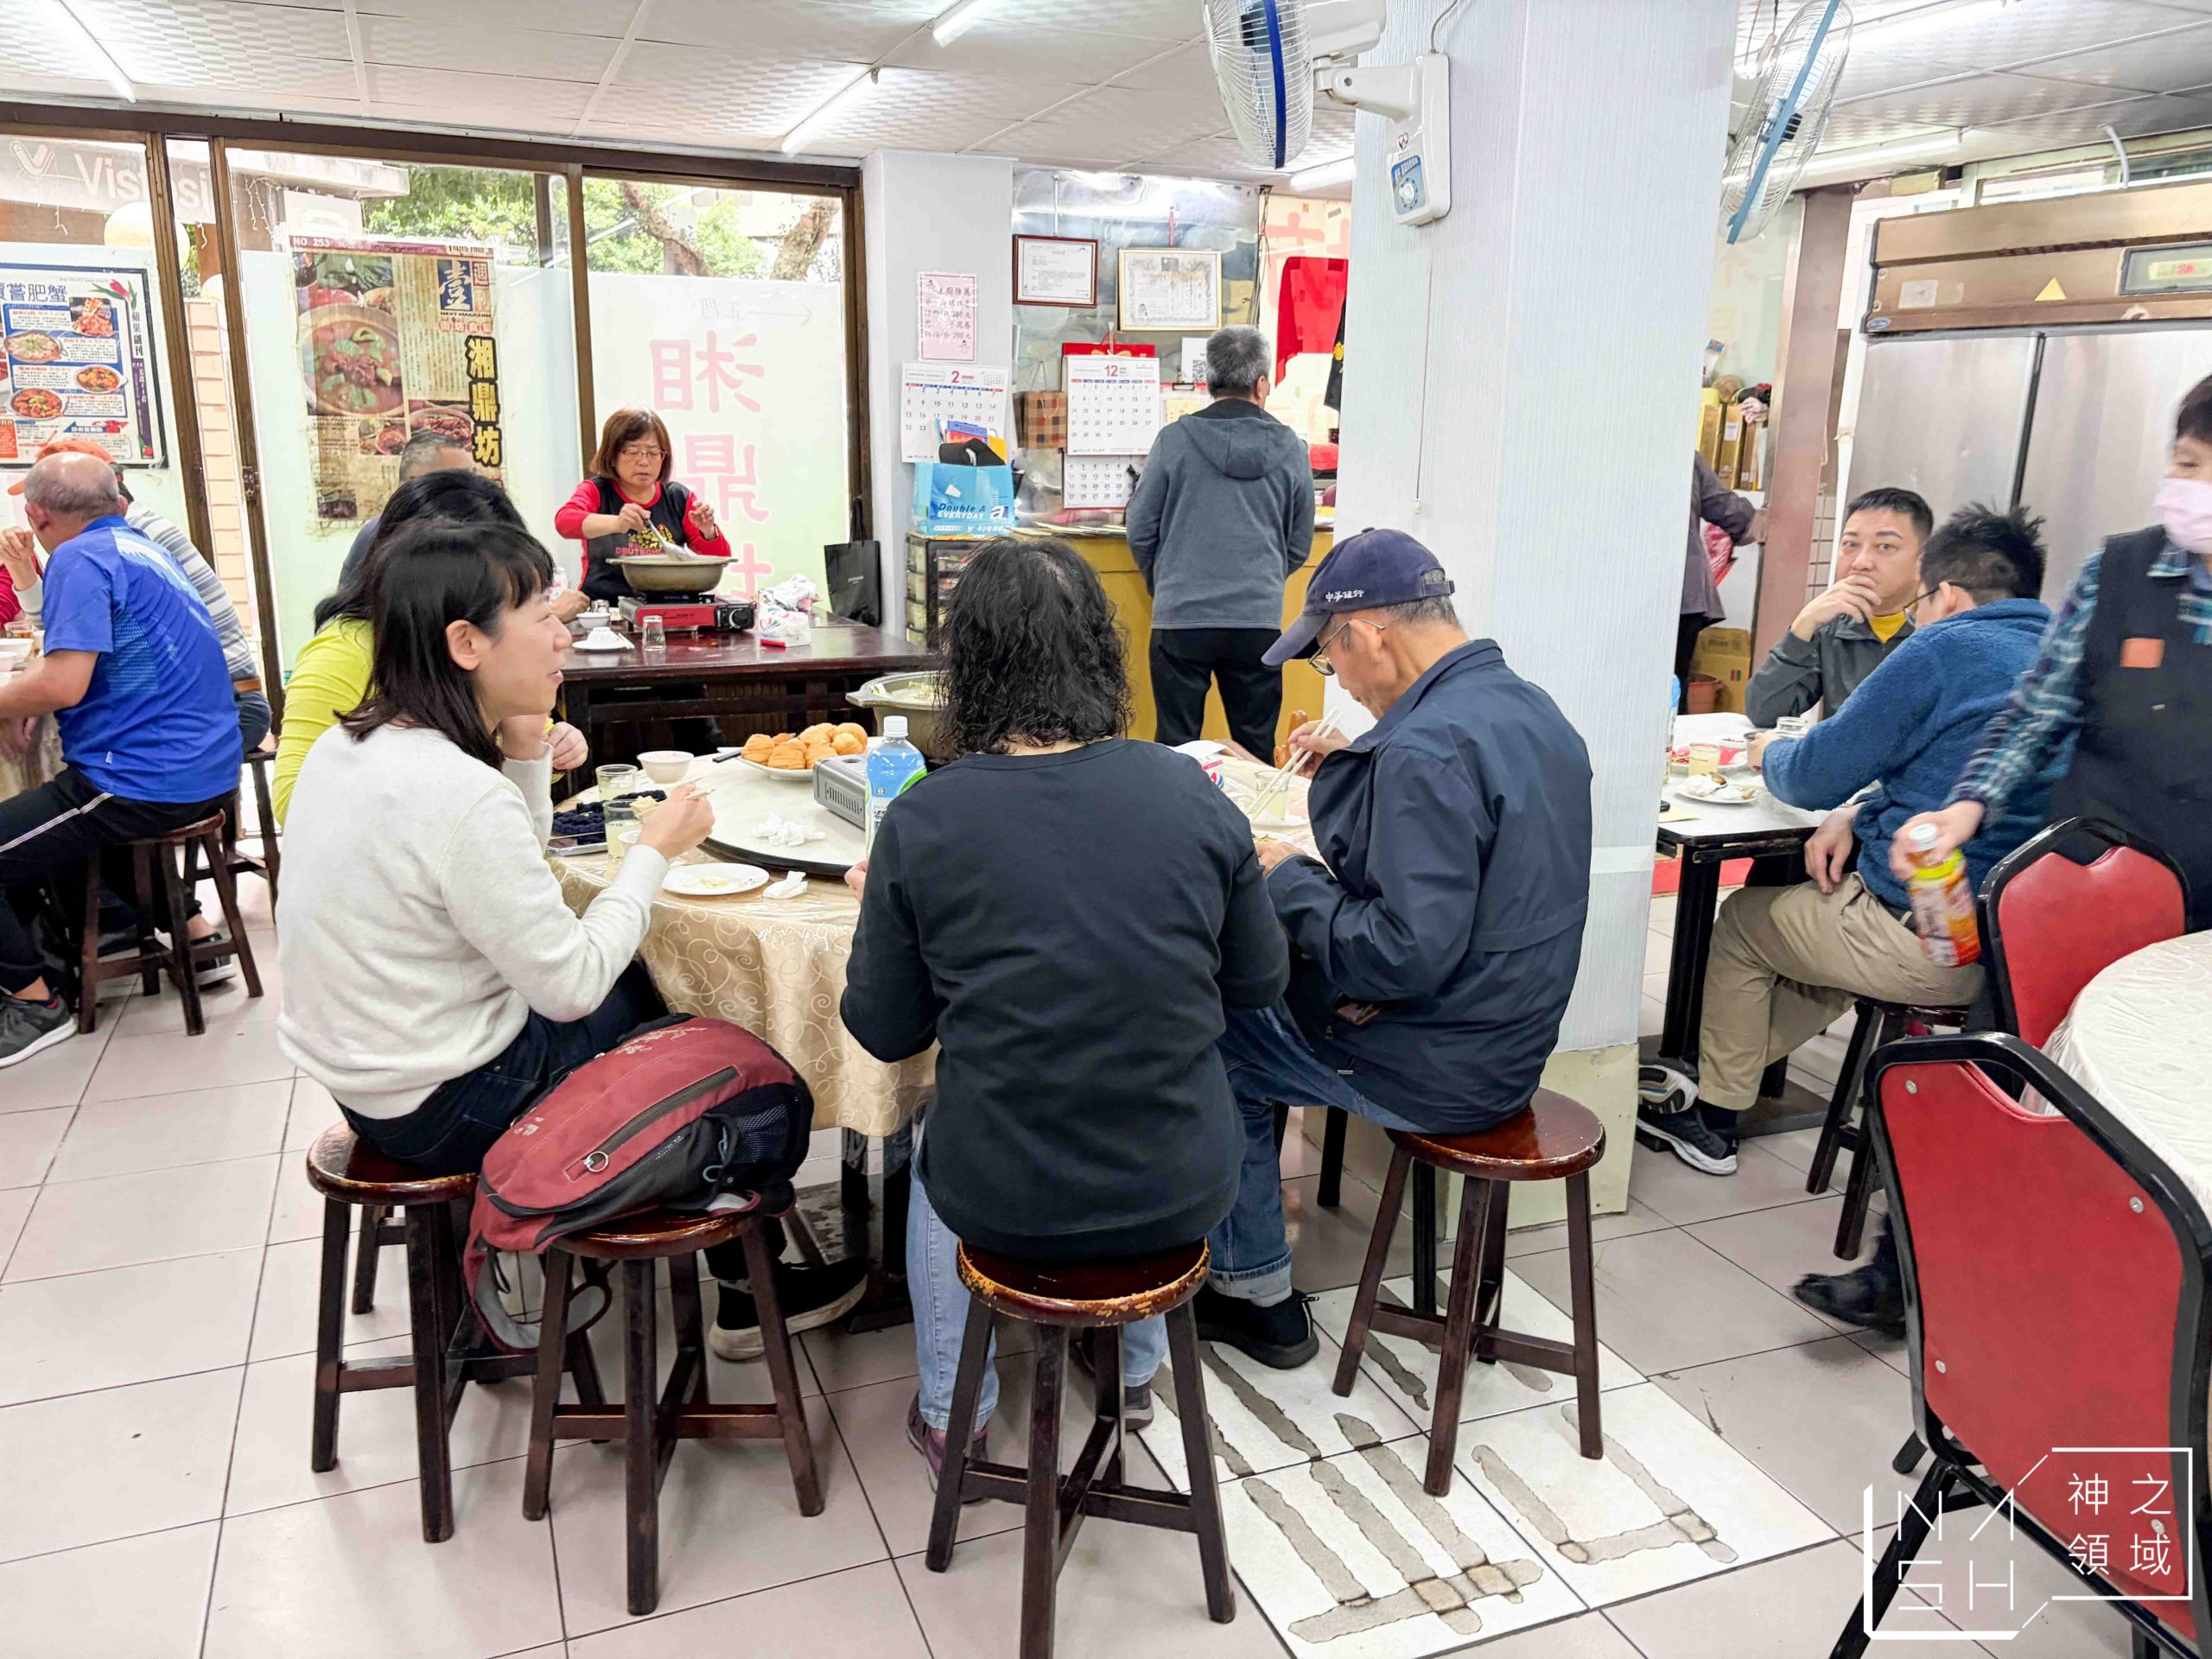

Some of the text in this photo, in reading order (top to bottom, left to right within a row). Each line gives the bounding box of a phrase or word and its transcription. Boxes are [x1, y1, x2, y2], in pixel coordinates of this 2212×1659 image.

[293, 237, 308, 246] NO
[312, 238, 330, 247] 253
[1104, 365, 1119, 377] 12
[950, 371, 960, 384] 2
[465, 335, 502, 467] 湘鼎坊
[938, 503, 976, 512] Double
